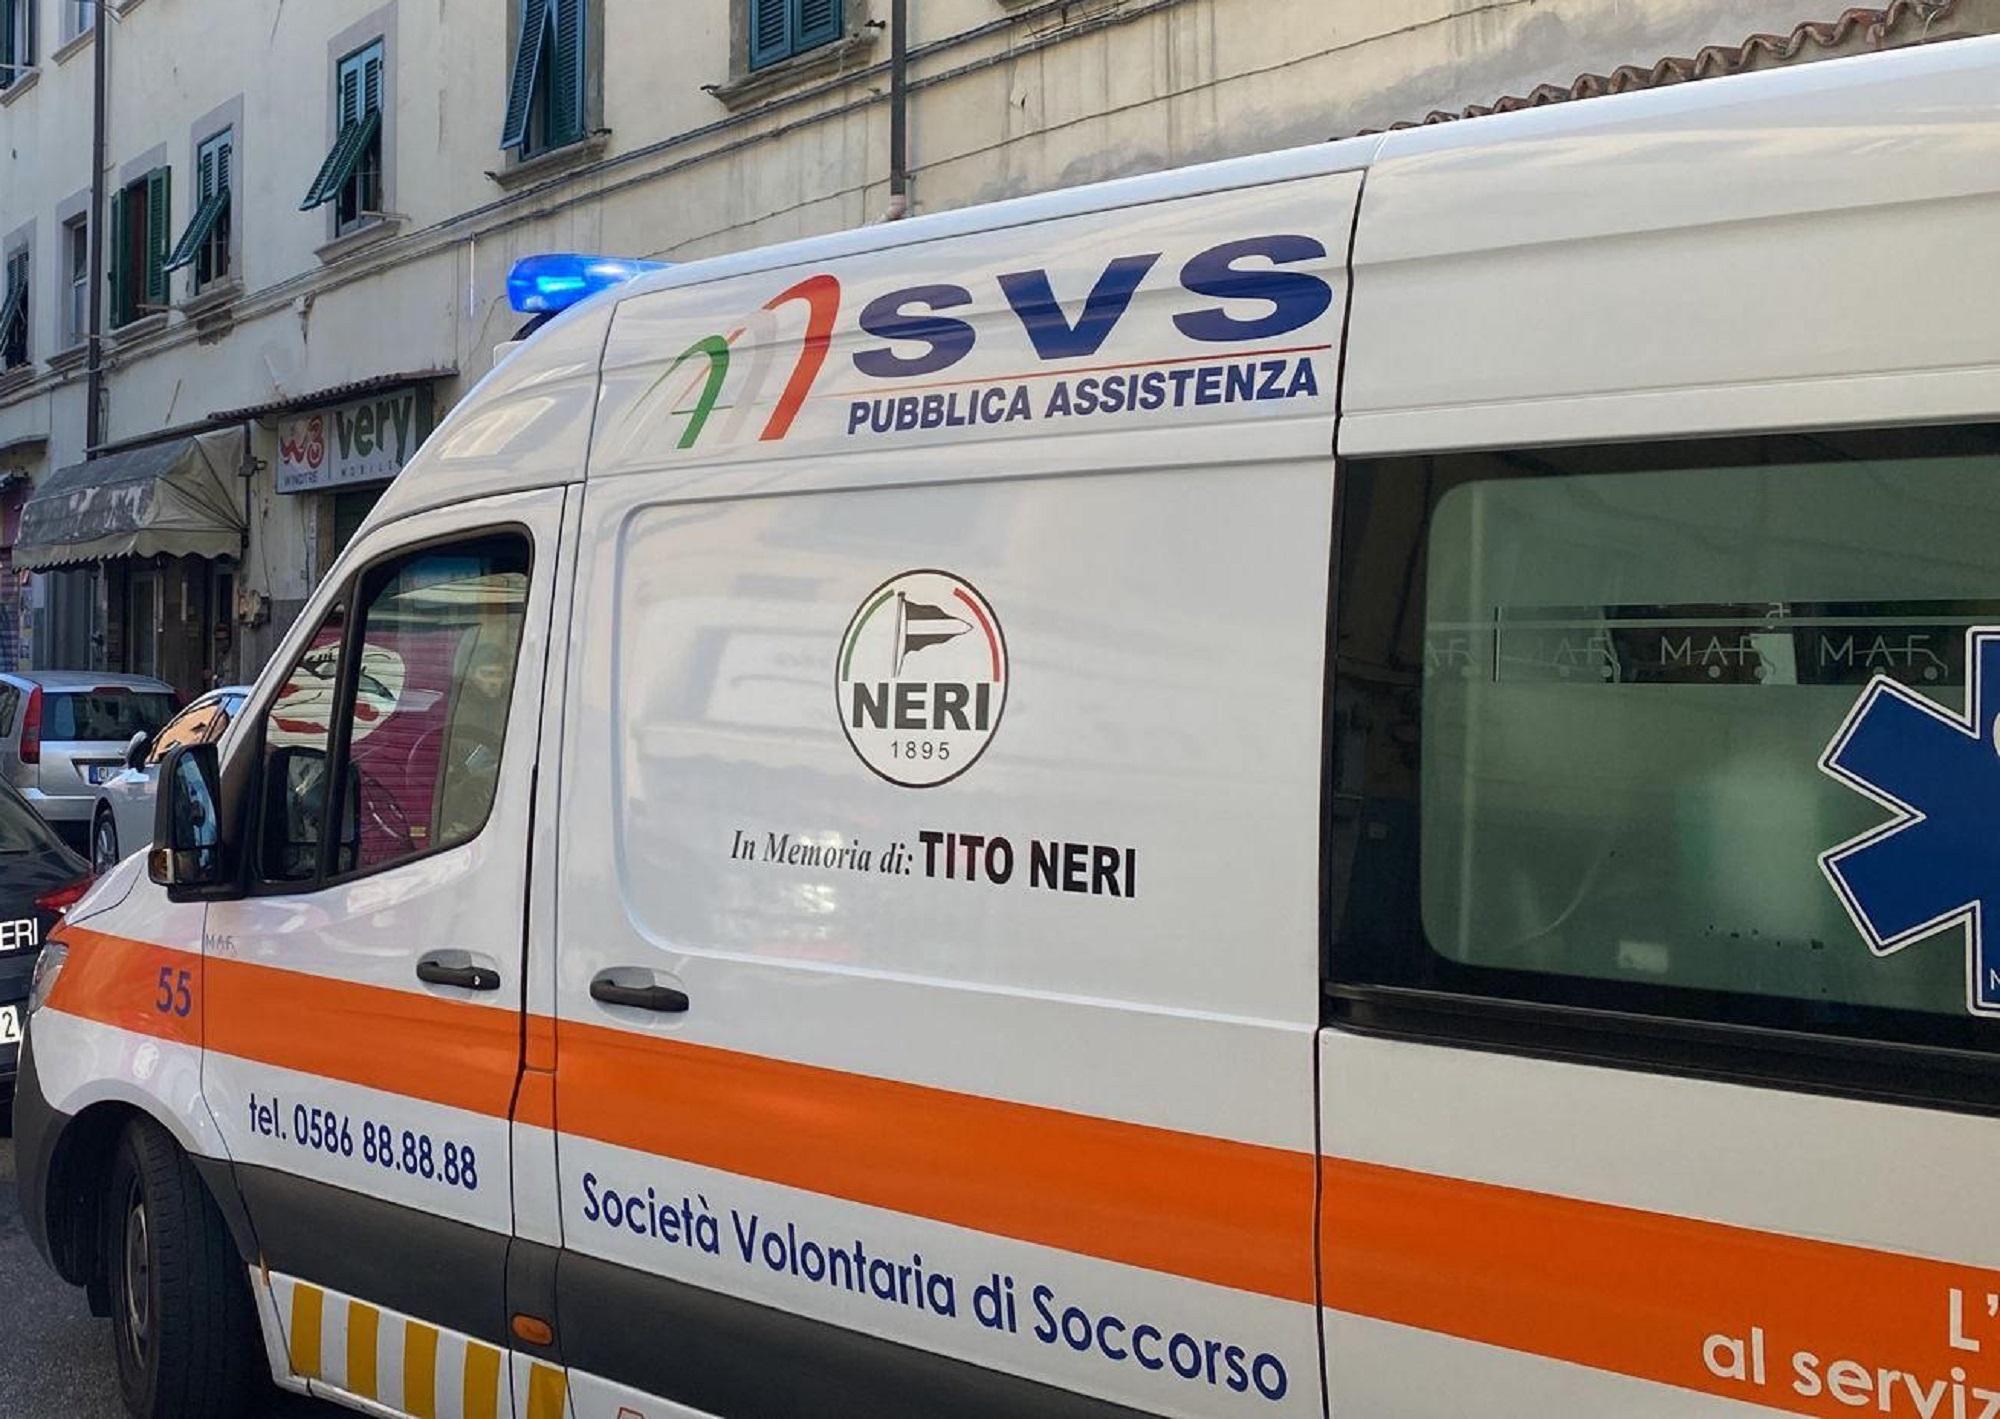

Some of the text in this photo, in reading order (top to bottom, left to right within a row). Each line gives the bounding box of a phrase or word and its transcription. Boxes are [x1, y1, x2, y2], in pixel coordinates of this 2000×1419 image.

[851, 234, 1333, 379] SVS
[847, 357, 1319, 435] PUBBLICA ASSISTENZA
[852, 682, 990, 731] NERI
[890, 740, 950, 760] 1895
[730, 830, 1136, 898] In Memoria di: TITO NERI
[0, 917, 39, 950] ERI
[155, 966, 192, 1018] 55
[2, 1010, 15, 1038] 2
[249, 1092, 478, 1190] tel. 0586 88.88.88
[583, 1172, 1288, 1401] Società Volontaria di Soccorso
[1702, 1326, 1766, 1386] al
